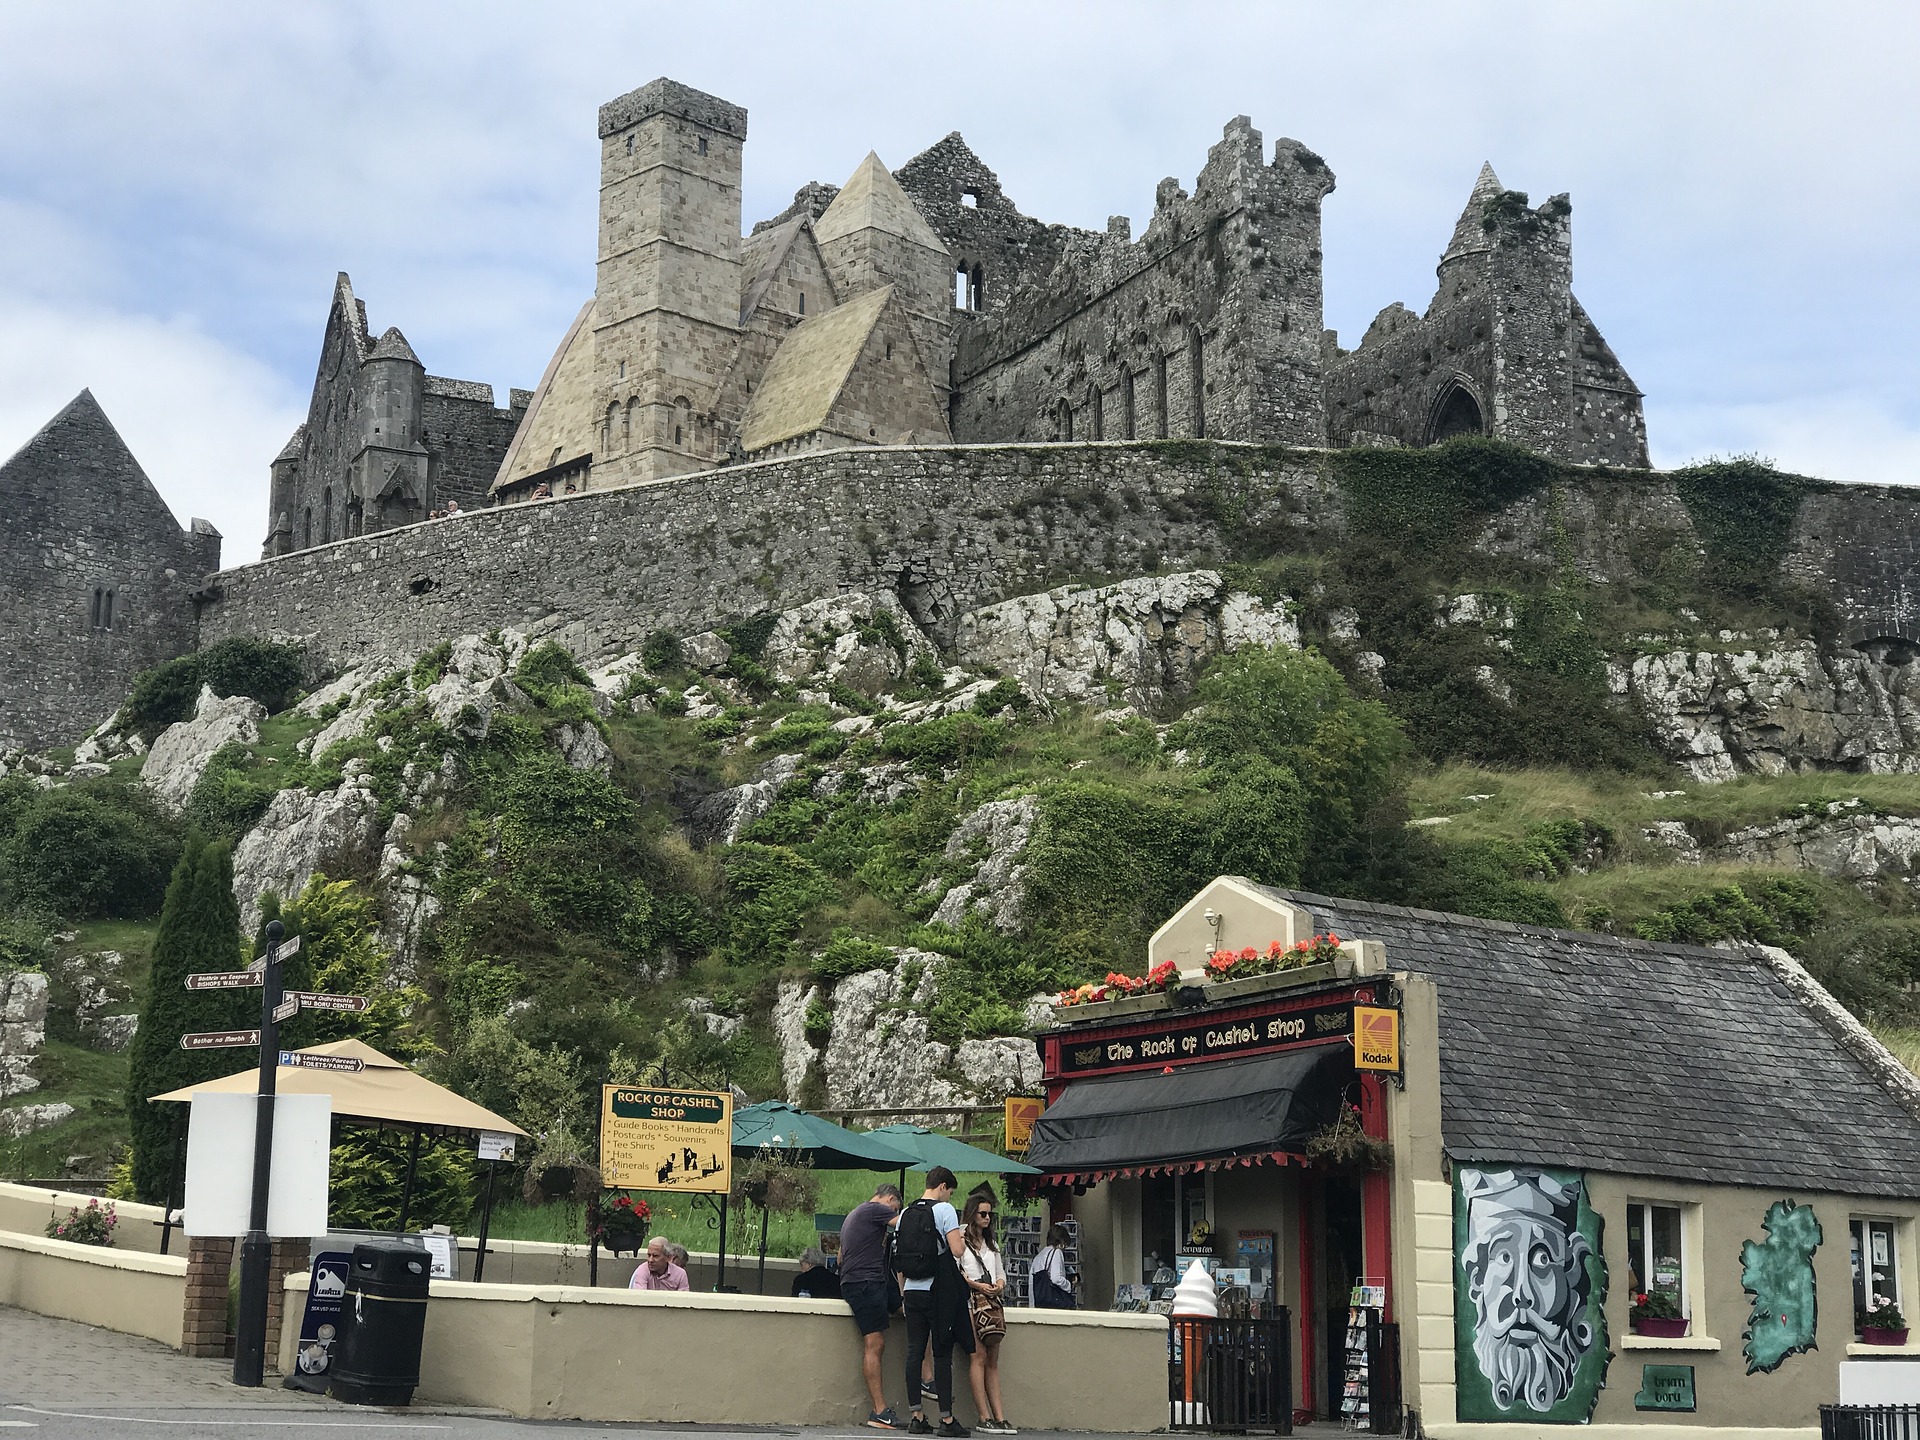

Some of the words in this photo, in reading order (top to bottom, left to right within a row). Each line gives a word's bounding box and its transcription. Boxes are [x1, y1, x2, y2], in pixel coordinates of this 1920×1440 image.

[1107, 1042, 1134, 1061] The
[1141, 1035, 1176, 1057] Rock
[1205, 1022, 1260, 1048] Cashel
[1267, 1018, 1306, 1039] Shop
[282, 1053, 289, 1064] P
[1362, 1051, 1393, 1065] Kodak
[617, 1091, 652, 1104] ROCK
[653, 1094, 670, 1105] OF
[672, 1097, 719, 1109] CASHEL
[651, 1107, 685, 1118] SHOP
[613, 1120, 640, 1129] Guide
[642, 1121, 669, 1131] Books
[677, 1124, 725, 1135] Handcrafts
[613, 1130, 656, 1140] Postcards
[663, 1133, 707, 1144] Souvenirs
[613, 1140, 629, 1149] Tee
[630, 1141, 655, 1151] Shirts
[612, 1150, 633, 1159] Hats
[612, 1160, 650, 1170] Minerals
[611, 1170, 630, 1180] Ices
[1655, 1376, 1685, 1387] brian
[1655, 1391, 1681, 1402] boru
